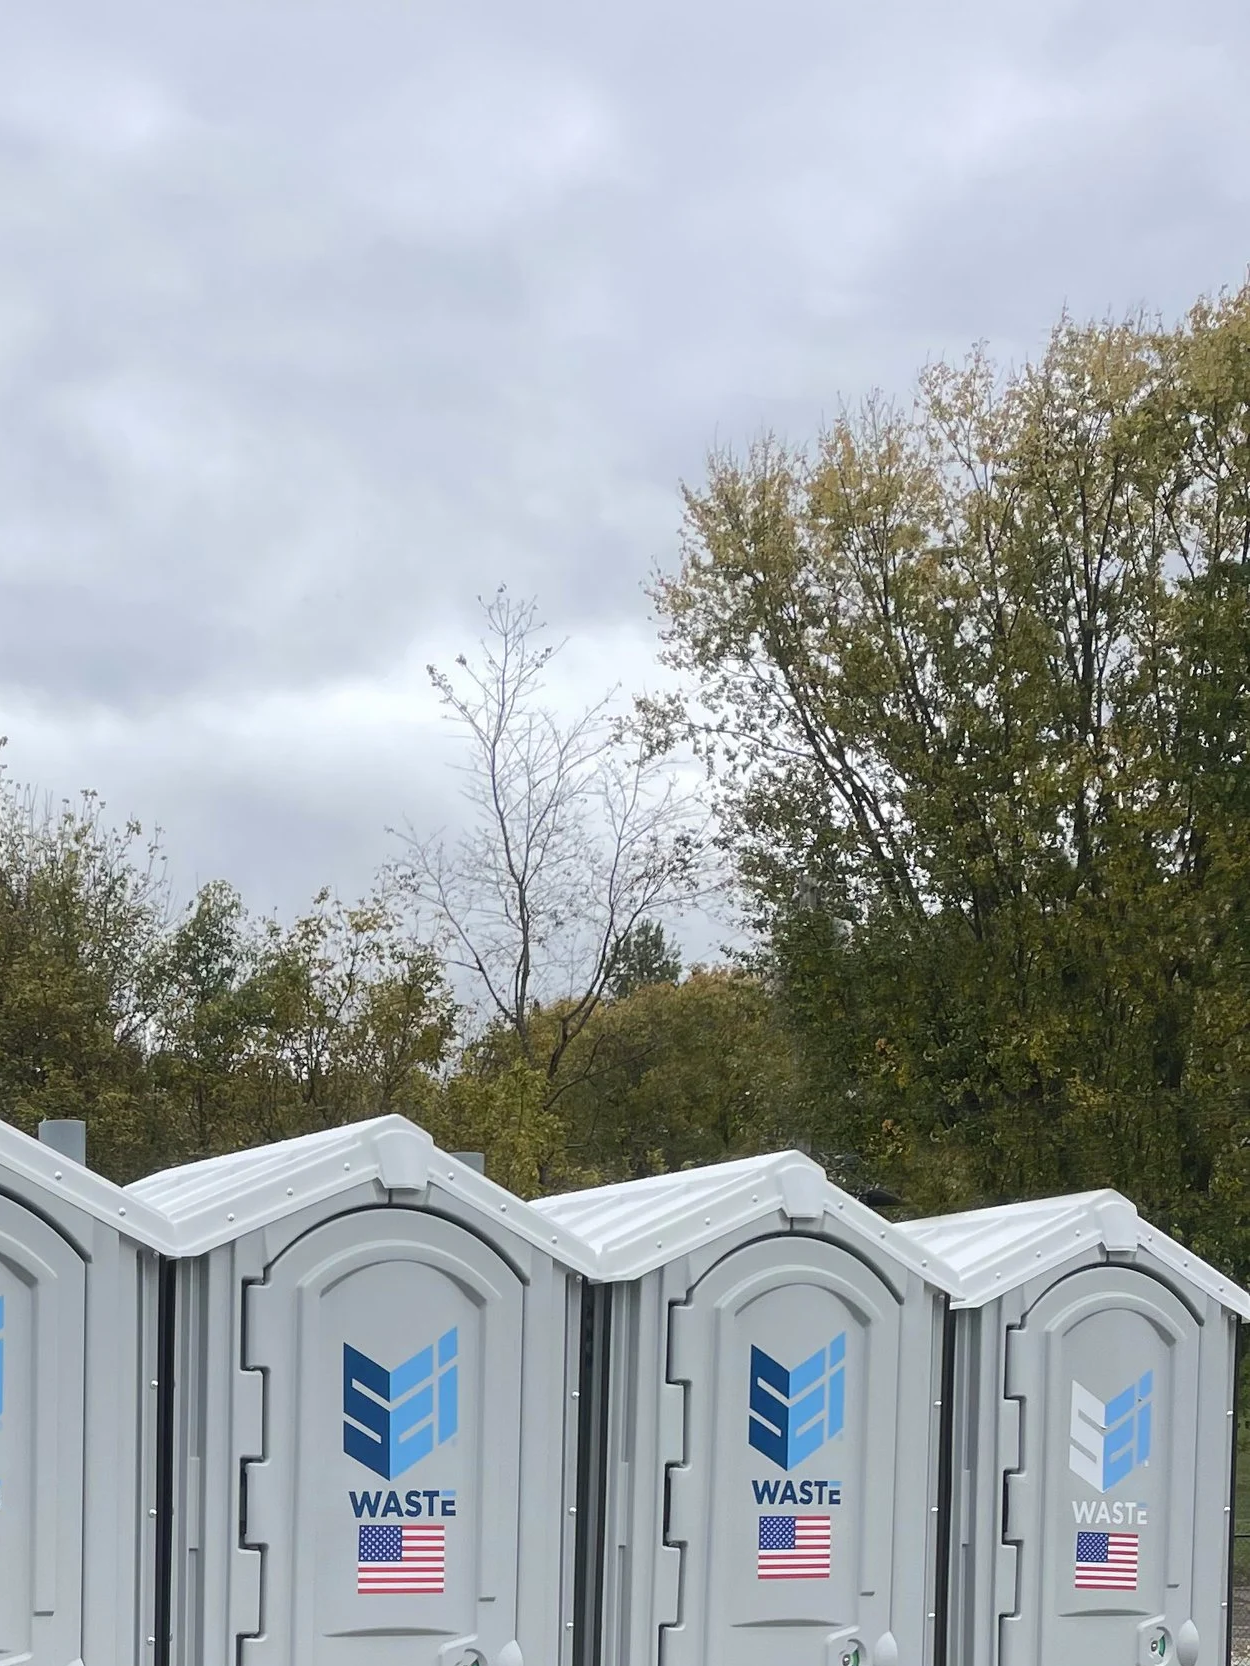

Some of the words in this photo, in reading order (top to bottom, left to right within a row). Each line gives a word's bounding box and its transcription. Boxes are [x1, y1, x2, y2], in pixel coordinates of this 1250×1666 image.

[349, 1489, 457, 1518] WASTE
[752, 1480, 842, 1506] WASTE
[1072, 1501, 1148, 1525] WASTE
